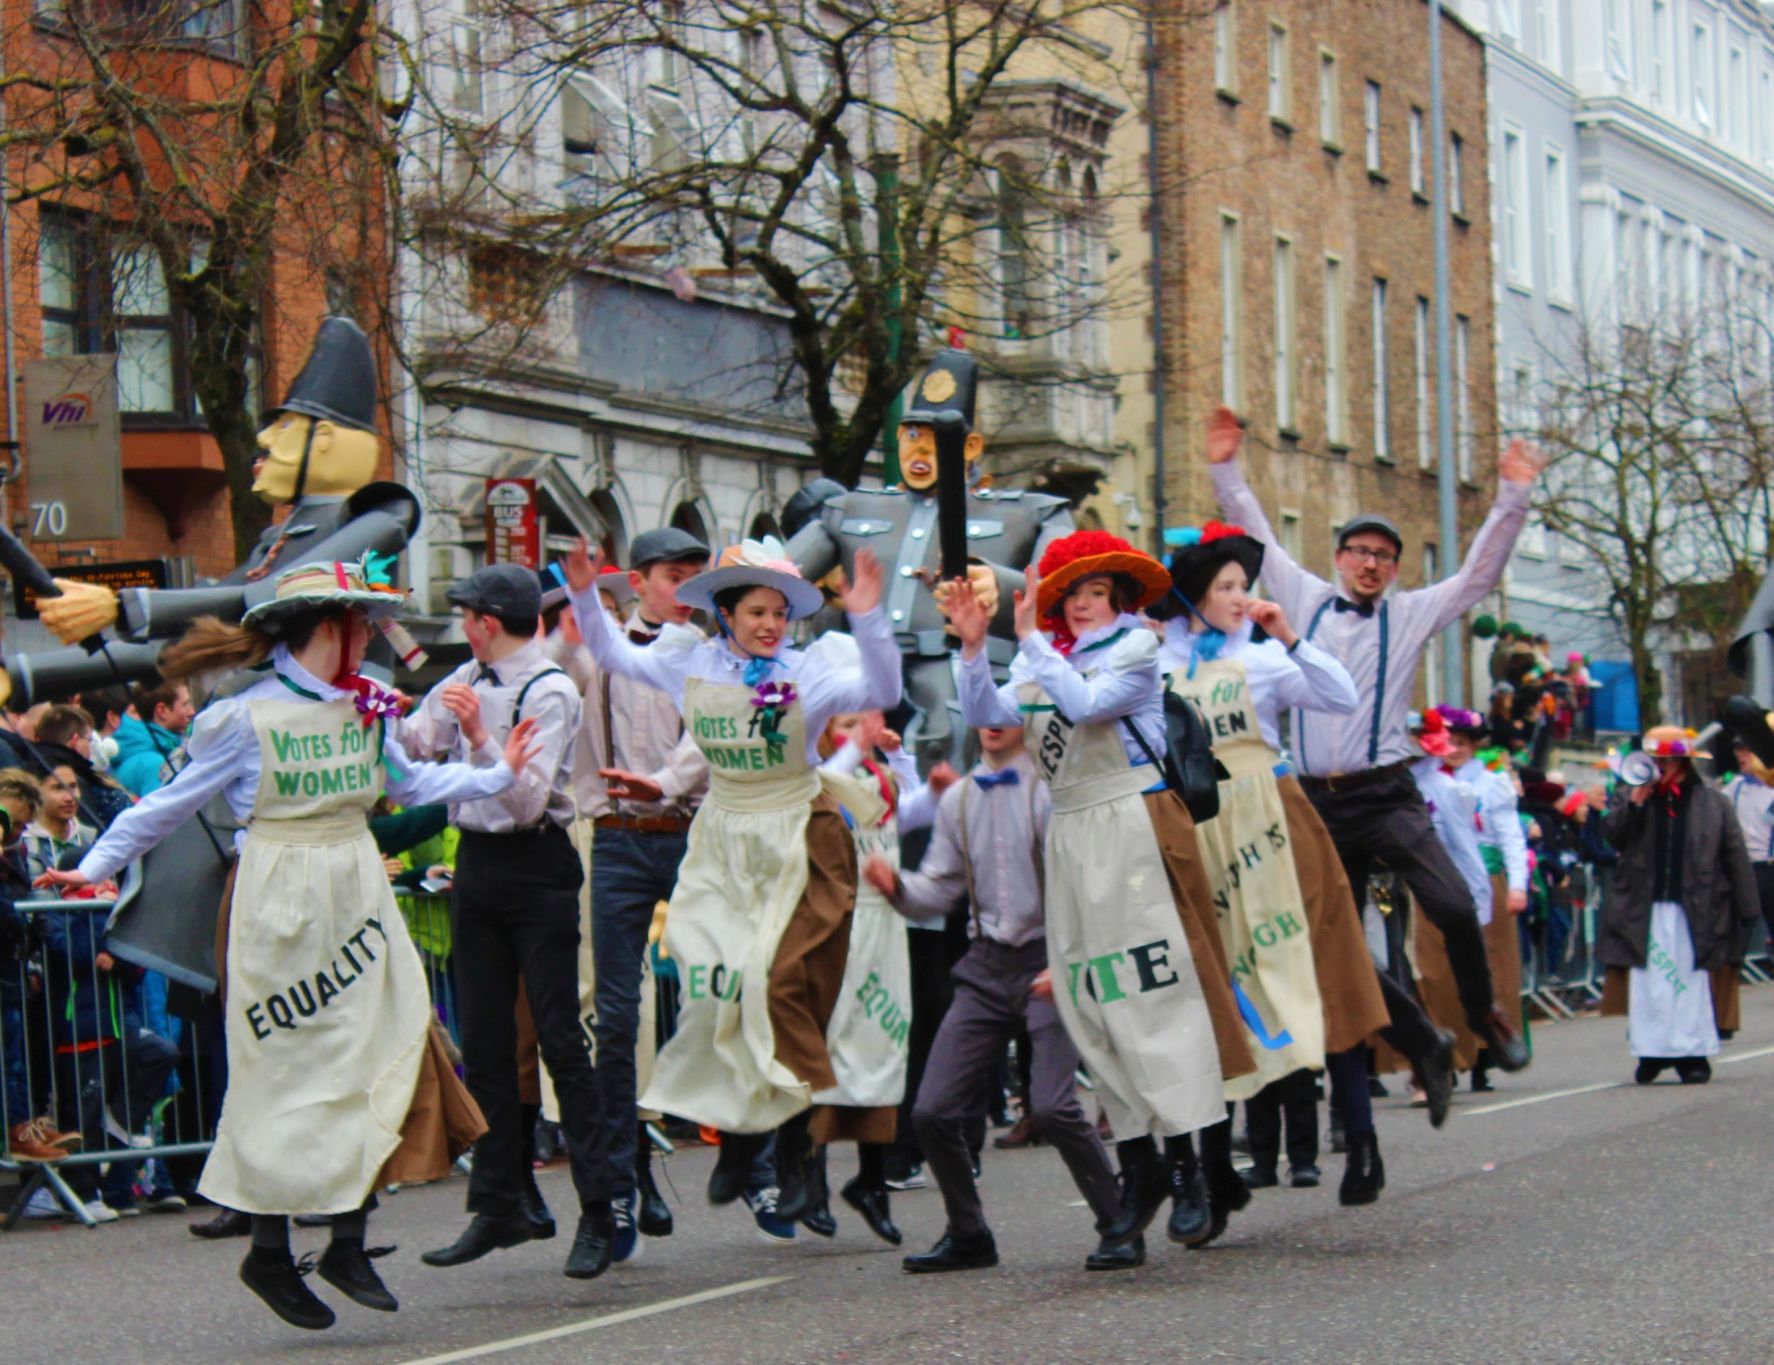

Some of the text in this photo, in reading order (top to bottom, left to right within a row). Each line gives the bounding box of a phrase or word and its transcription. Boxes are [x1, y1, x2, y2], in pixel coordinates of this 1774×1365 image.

[42, 401, 85, 425] Vhi
[31, 501, 66, 536] 70
[701, 746, 785, 770] WOMEN
[273, 762, 371, 797] WOMEN
[245, 907, 388, 1041] EQUALITY
